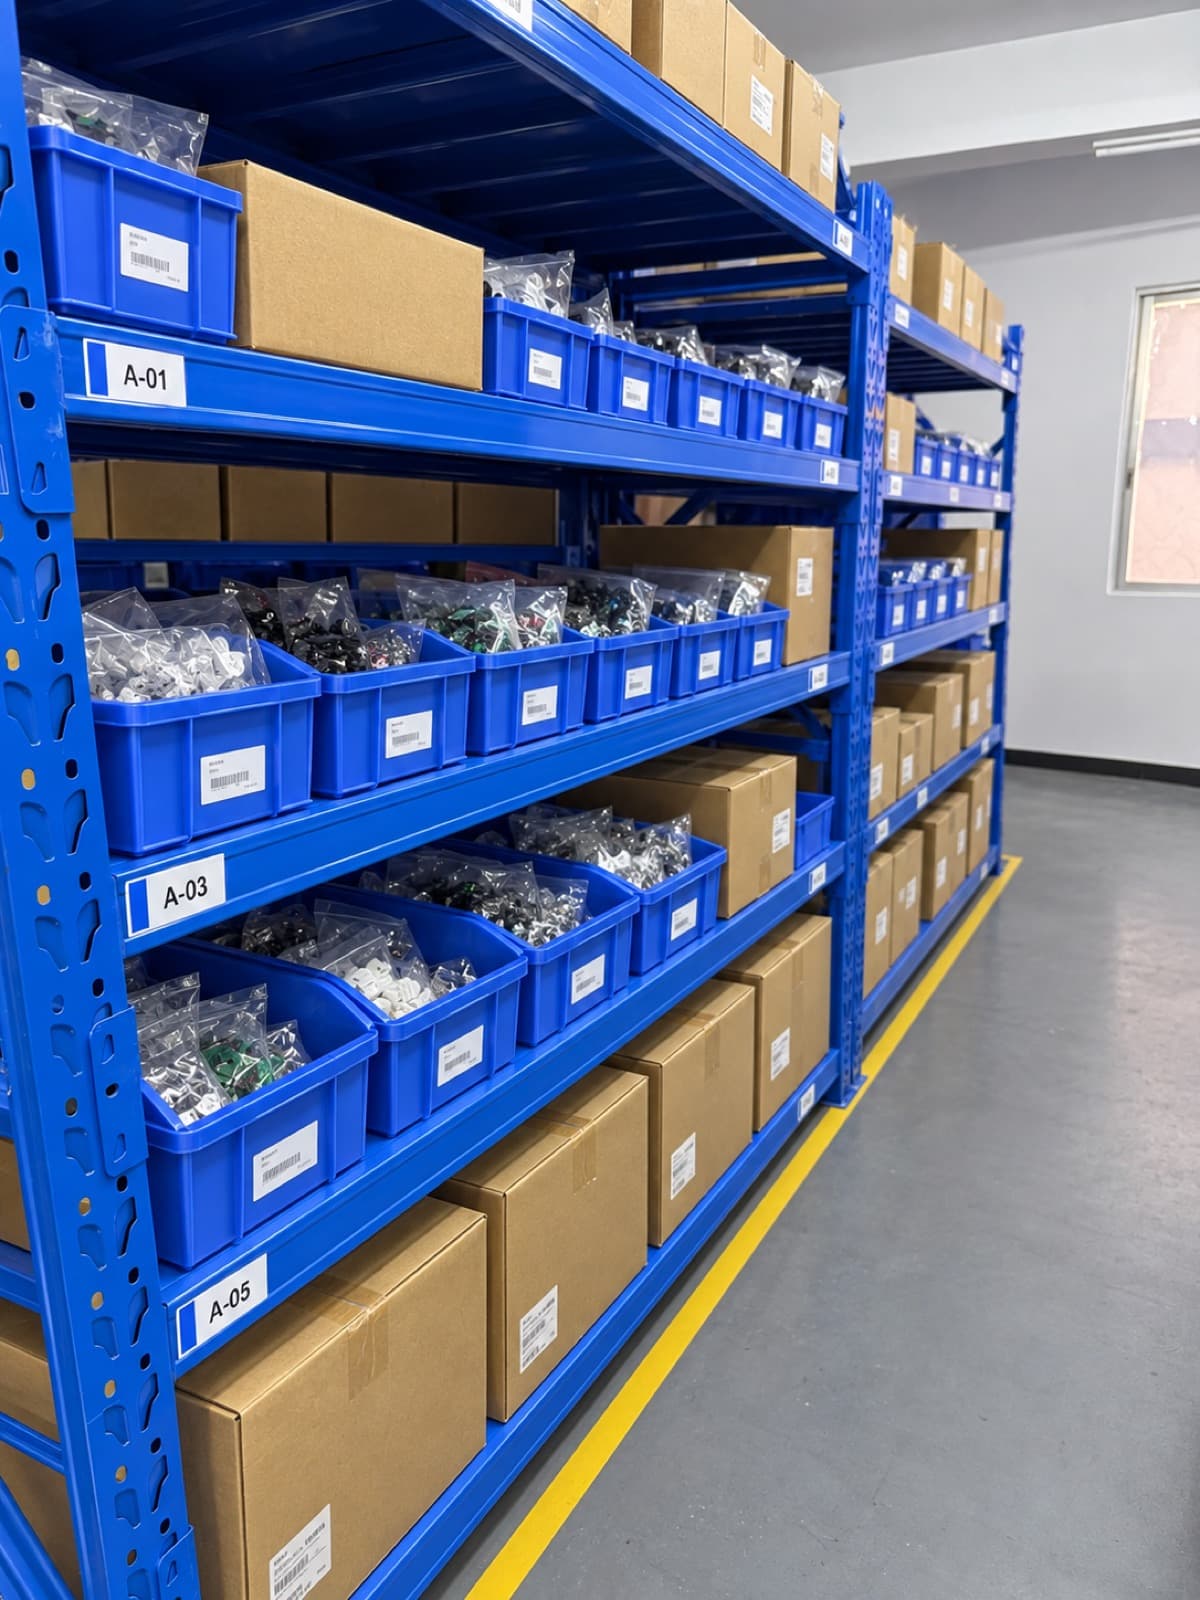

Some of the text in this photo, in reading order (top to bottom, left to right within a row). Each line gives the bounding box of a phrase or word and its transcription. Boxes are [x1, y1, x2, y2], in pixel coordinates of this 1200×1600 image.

[124, 364, 166, 390] A-01
[163, 875, 208, 909] A-03
[209, 1280, 251, 1324] A-05
